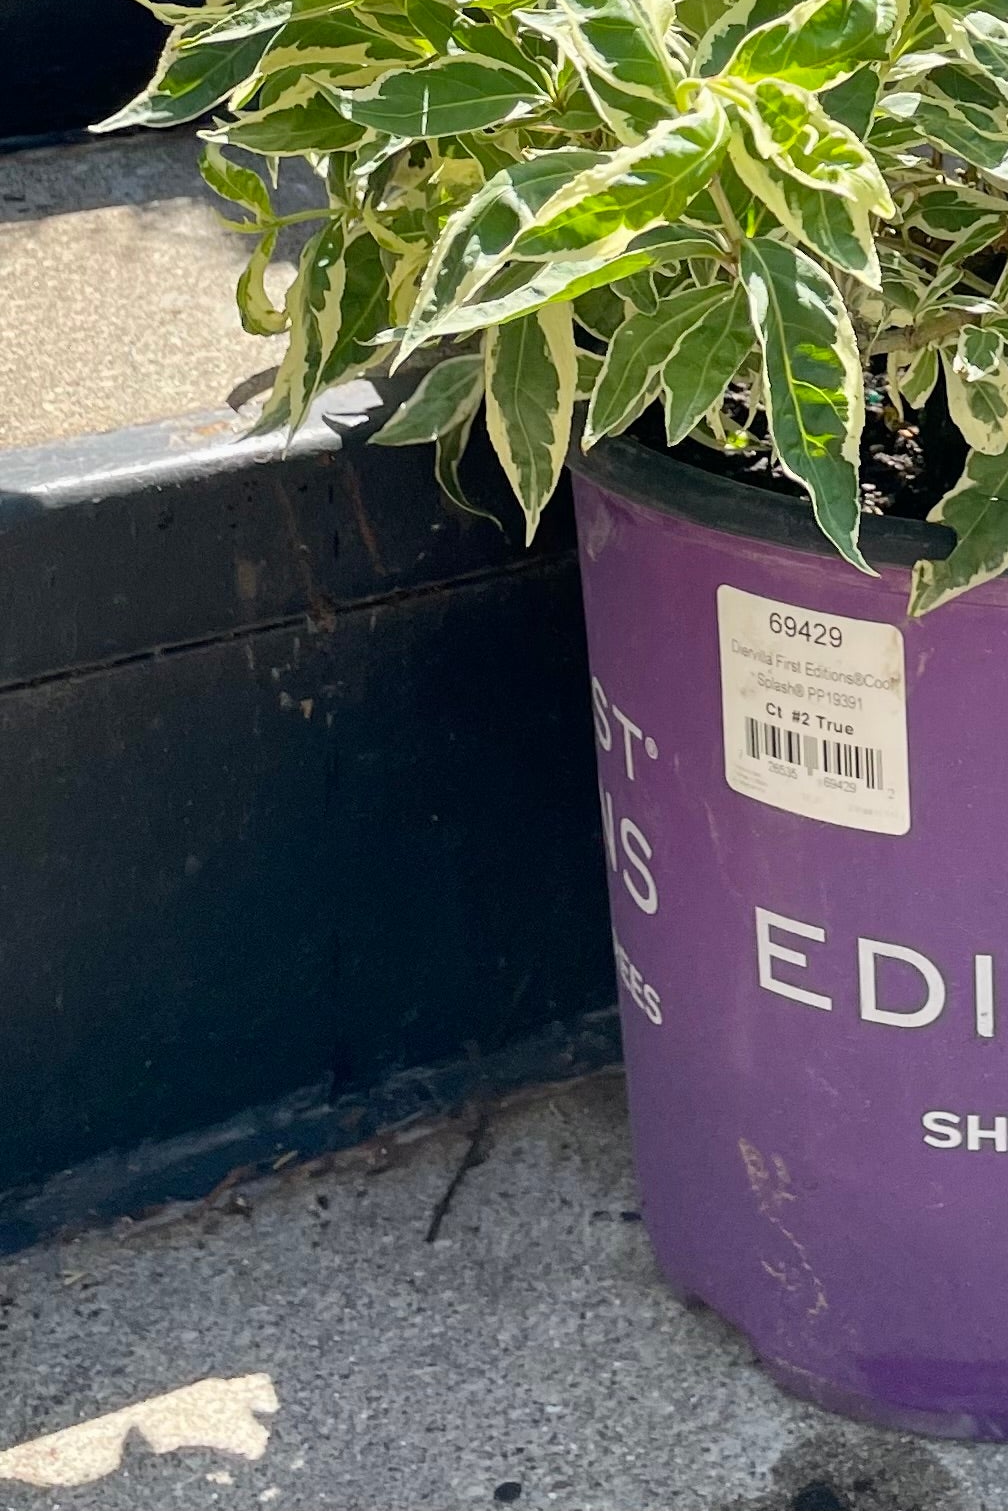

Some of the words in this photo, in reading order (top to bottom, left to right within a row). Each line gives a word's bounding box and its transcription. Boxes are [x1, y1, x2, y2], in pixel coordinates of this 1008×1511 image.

[769, 612, 843, 648] 69429
[731, 638, 773, 666] Diervilla
[776, 654, 801, 674] First
[807, 687, 864, 711] PP19391
[766, 702, 783, 719] Ct
[792, 710, 811, 727] #2
[816, 715, 855, 736] True
[823, 777, 857, 794] 69429
